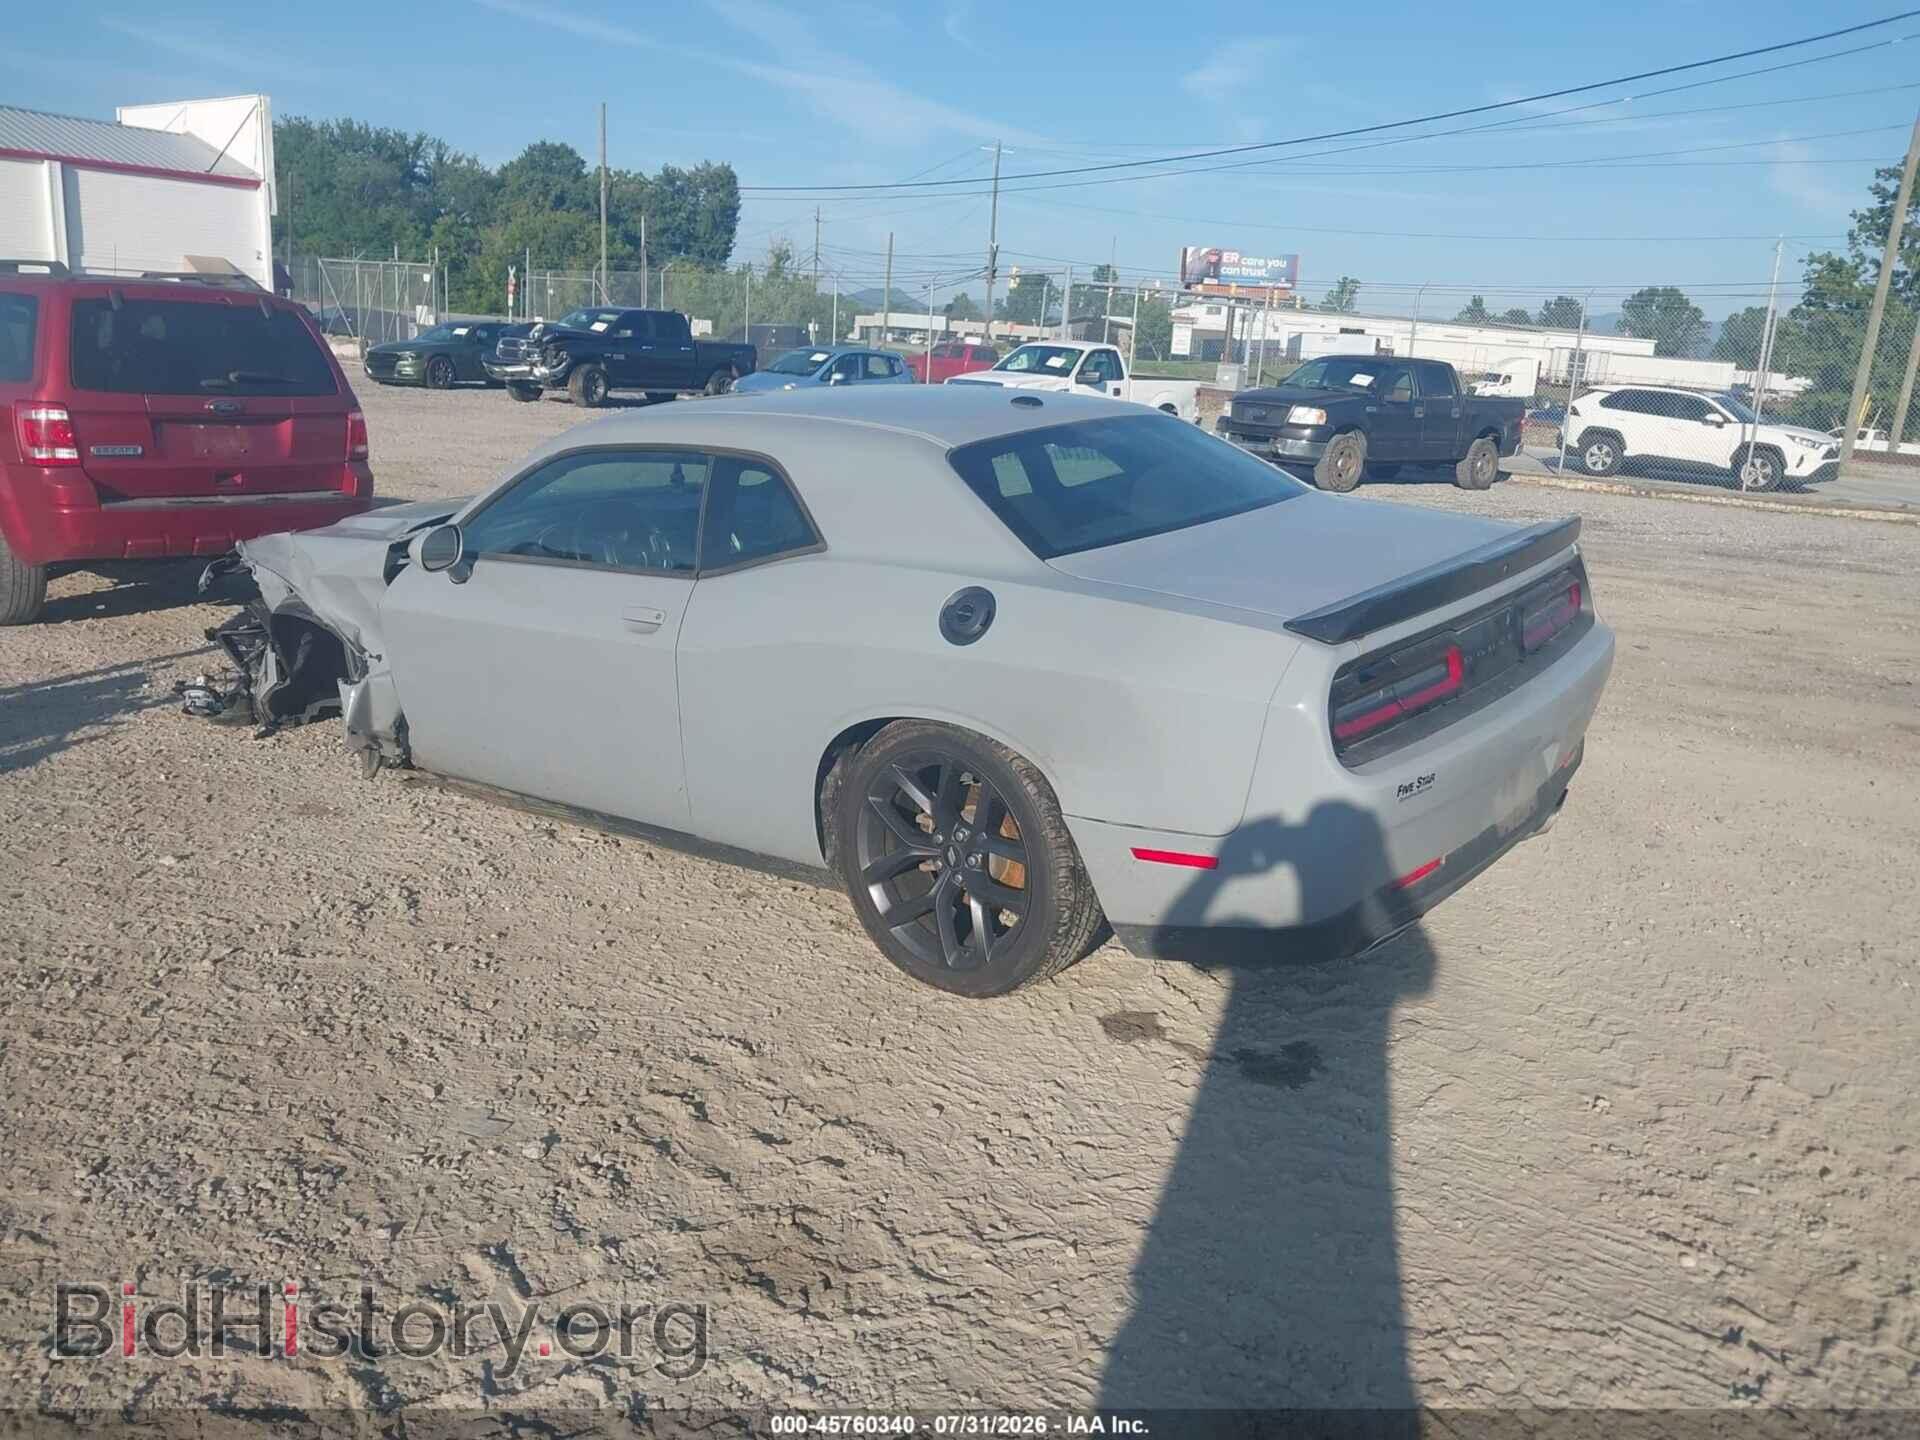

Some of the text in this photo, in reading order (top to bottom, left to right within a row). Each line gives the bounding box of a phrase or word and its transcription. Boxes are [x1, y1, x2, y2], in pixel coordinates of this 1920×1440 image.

[1222, 251, 1288, 269] ER care you
[1220, 265, 1240, 276] can
